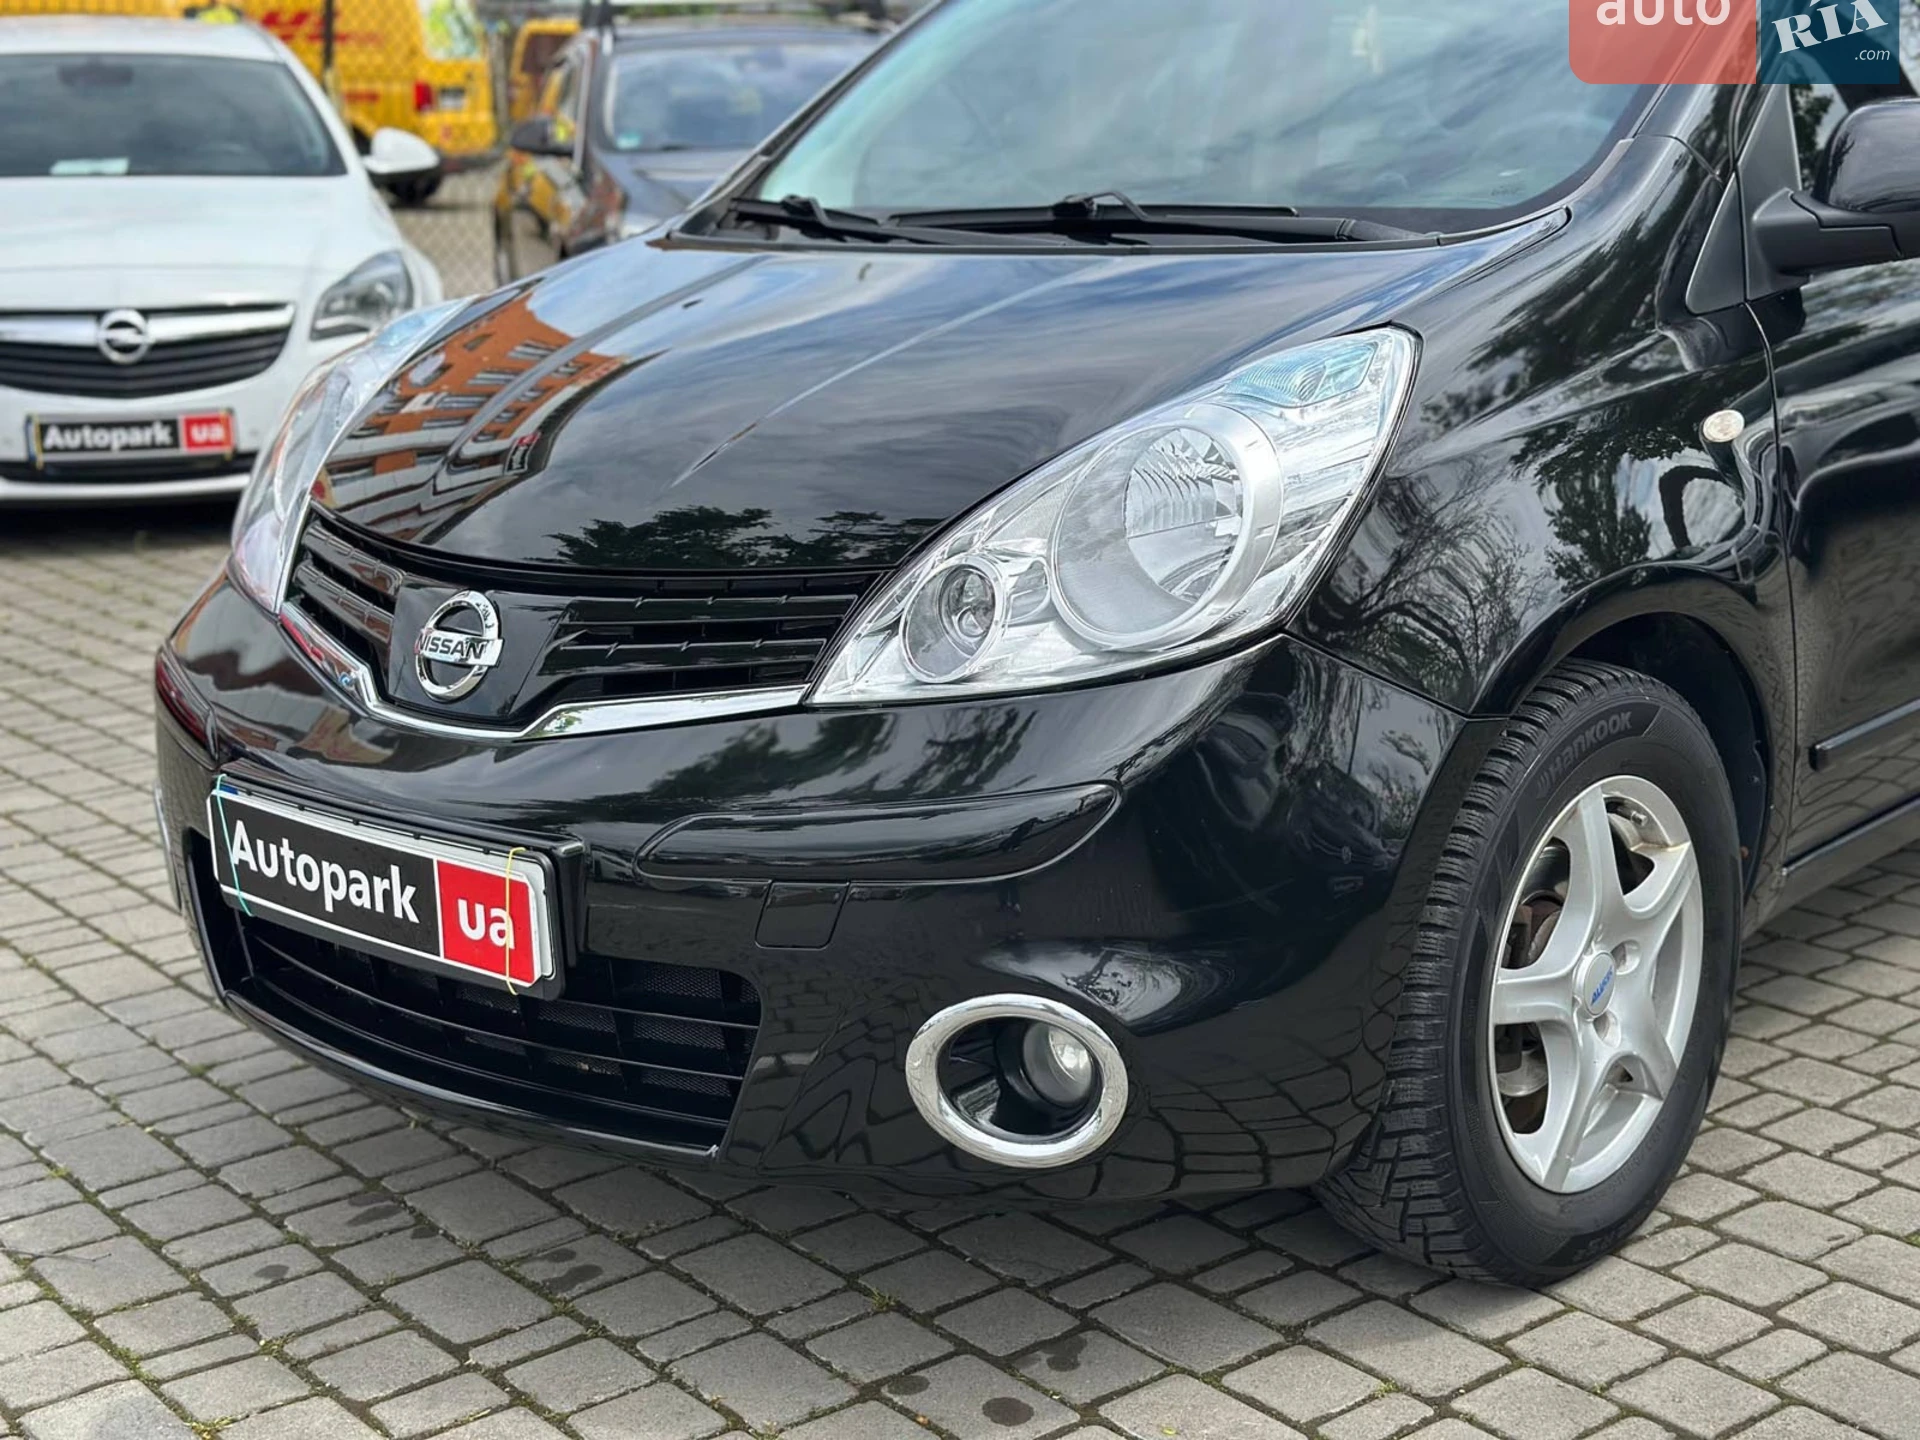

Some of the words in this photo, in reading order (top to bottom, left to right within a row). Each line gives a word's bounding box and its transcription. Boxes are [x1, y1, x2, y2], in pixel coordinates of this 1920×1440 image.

[43, 421, 173, 451] Autopark
[191, 423, 226, 443] ua
[416, 633, 488, 660] NISSAN
[231, 819, 420, 924] Autopark
[457, 897, 516, 950] ua
